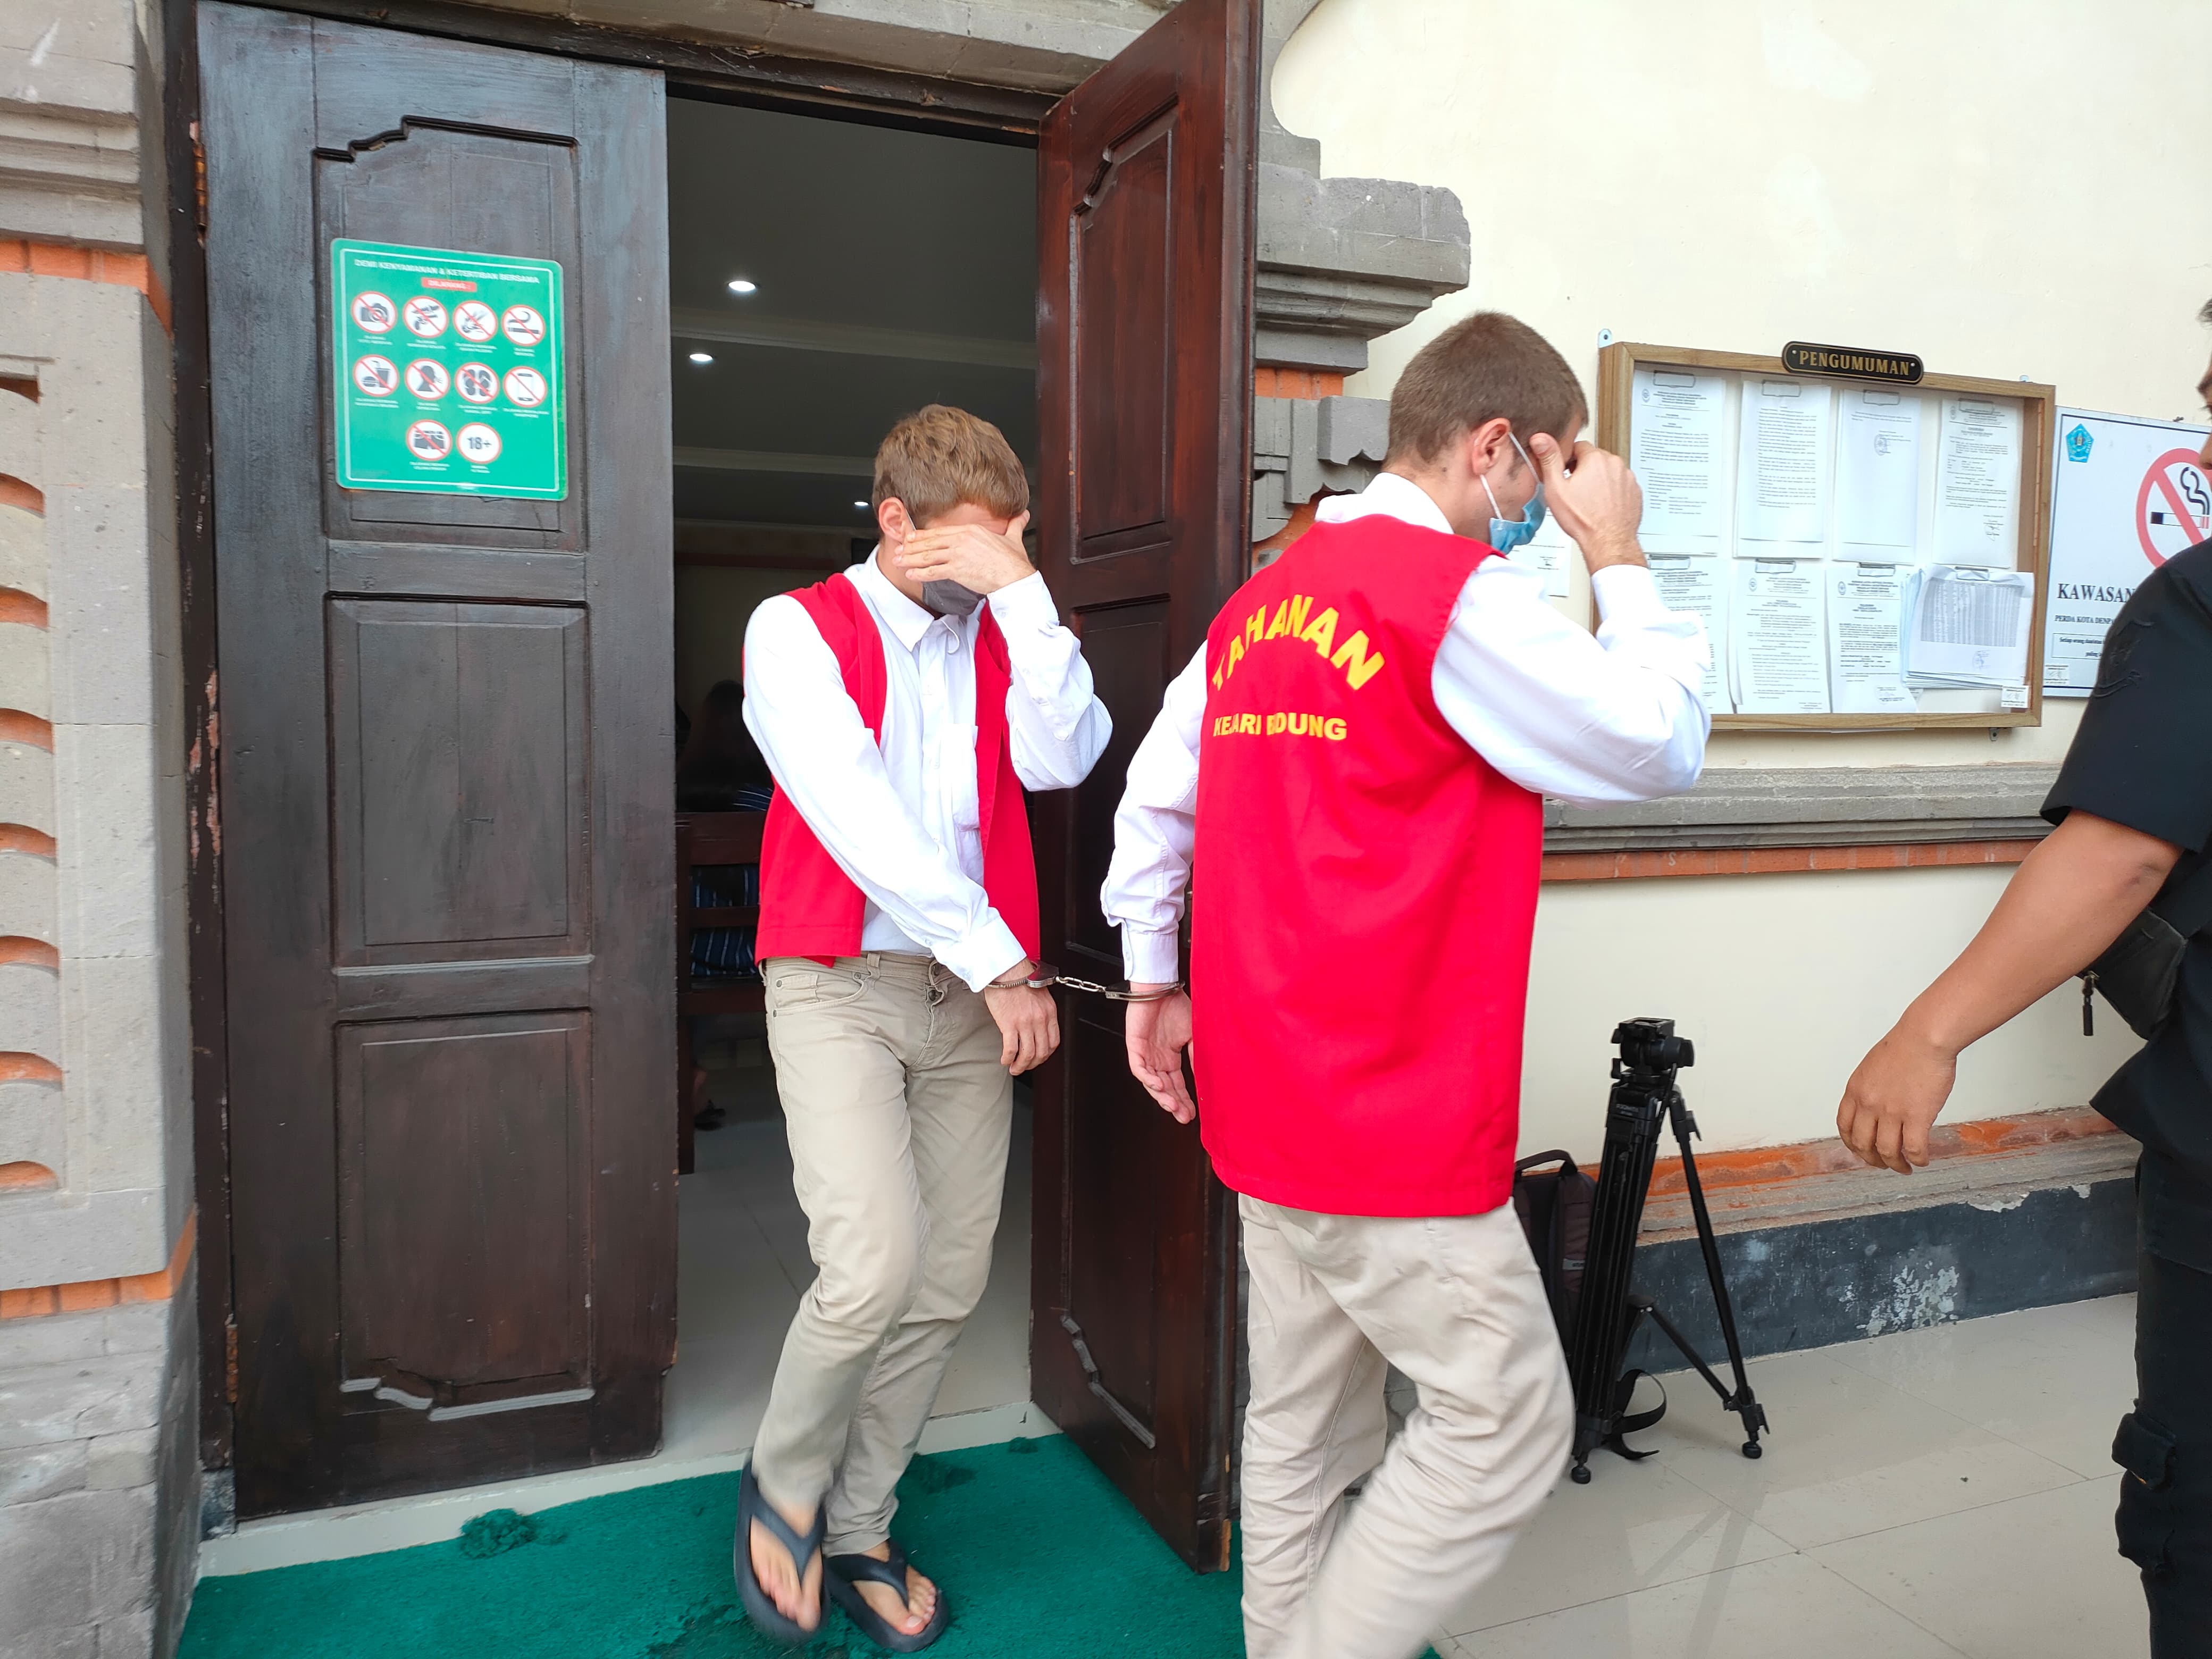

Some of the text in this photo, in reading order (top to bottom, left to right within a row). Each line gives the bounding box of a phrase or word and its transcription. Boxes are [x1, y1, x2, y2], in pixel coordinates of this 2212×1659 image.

[1799, 350, 1909, 376] PENGUMUMAN
[467, 437, 492, 450] 18+
[2057, 583, 2135, 603] KAWASAN
[1213, 712, 1347, 740] KEARI BDUNG
